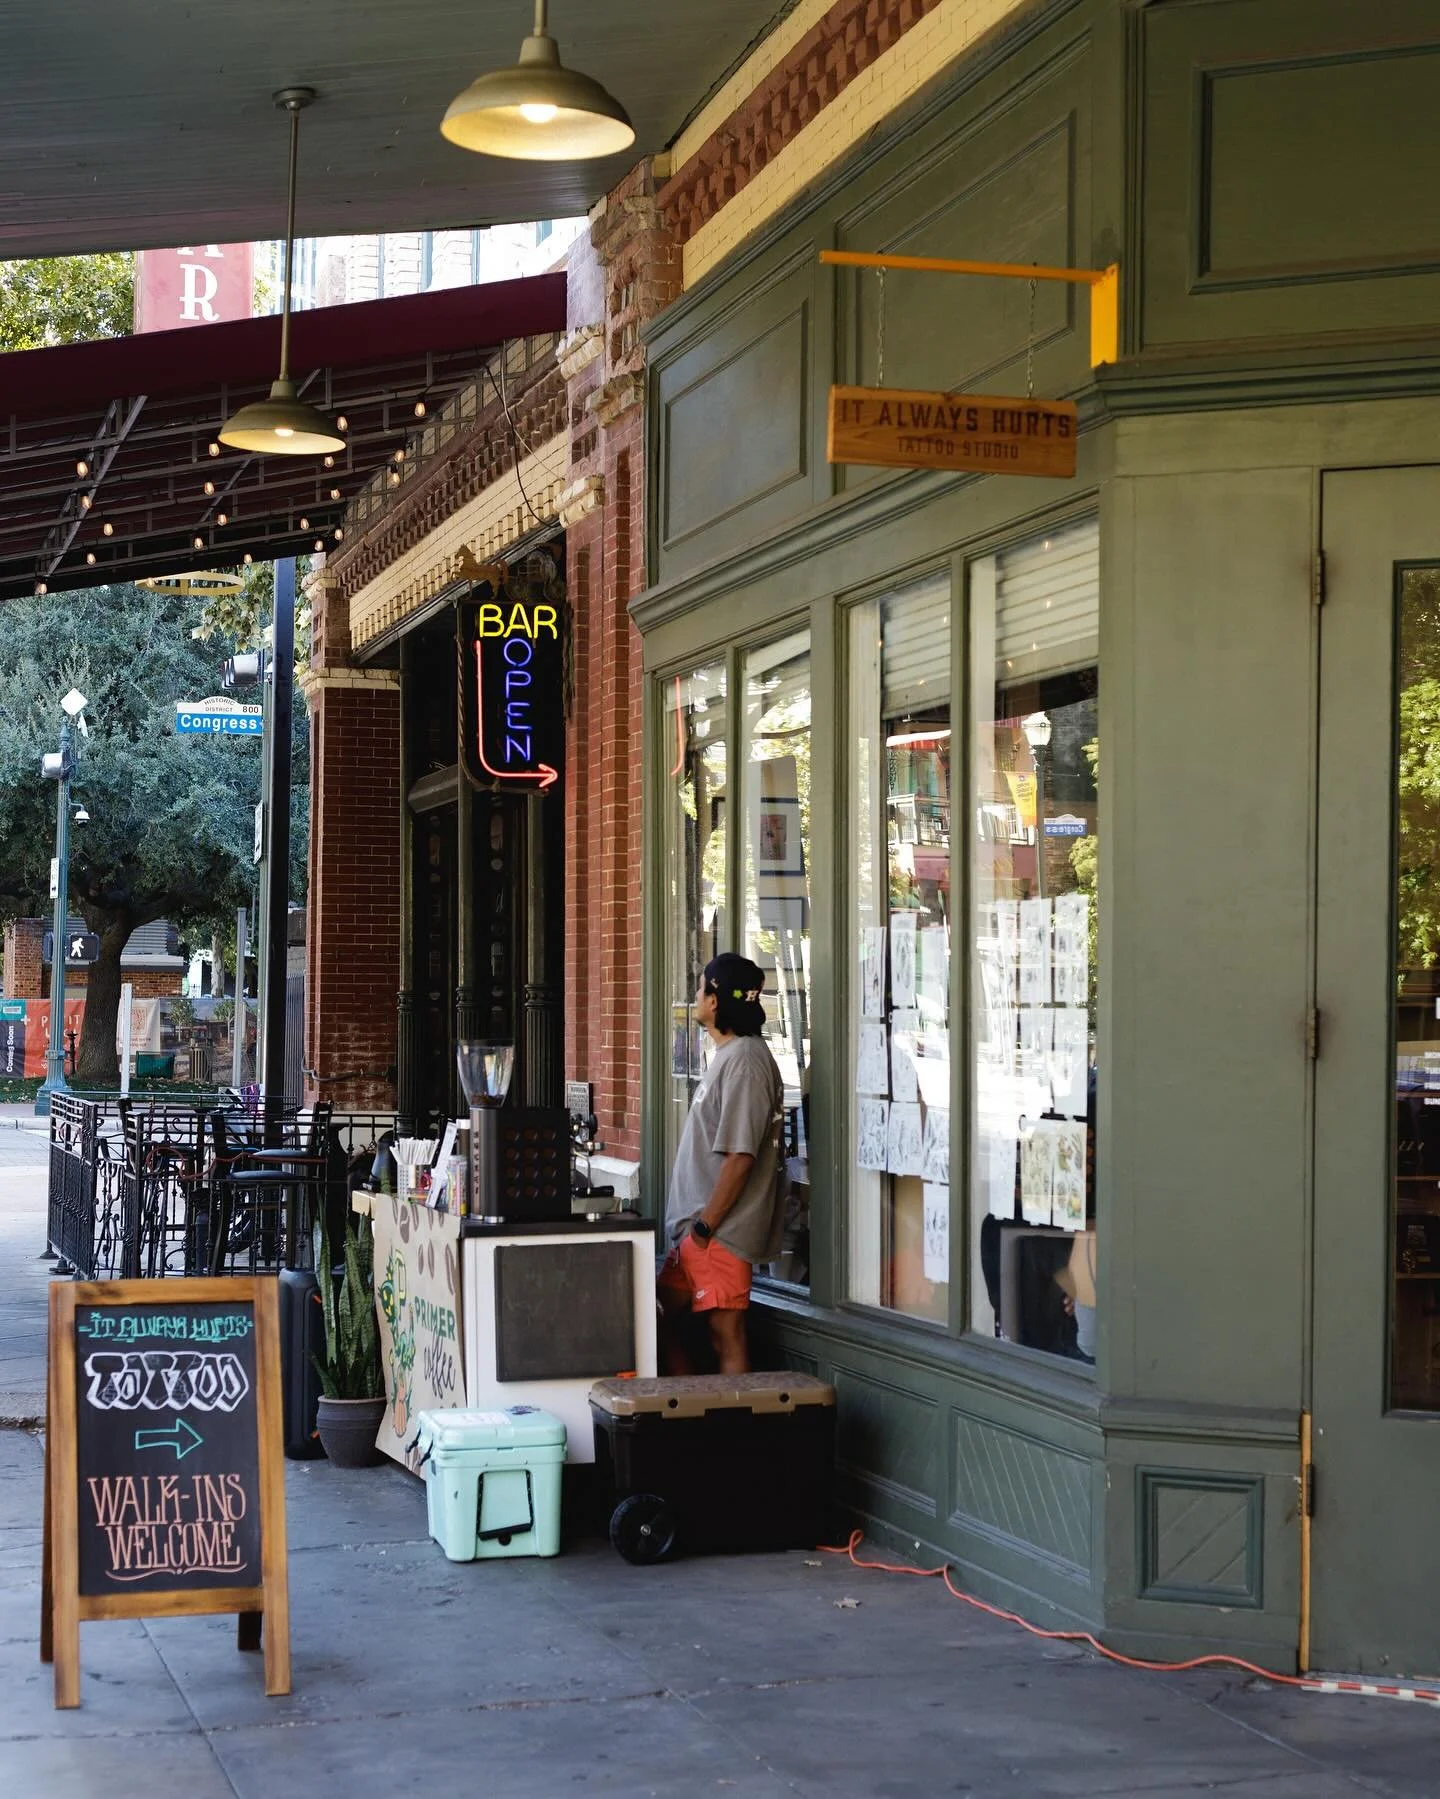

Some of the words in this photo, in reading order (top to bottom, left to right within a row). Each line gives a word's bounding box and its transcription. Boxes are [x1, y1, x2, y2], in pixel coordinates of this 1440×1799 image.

[841, 398, 865, 424] IT
[877, 401, 979, 433] ALWAYS
[992, 409, 1073, 438] HURTS
[896, 436, 954, 456] TATTOO
[963, 442, 1020, 460] STUDIO
[479, 602, 558, 640] BAR
[242, 705, 259, 714] 800
[503, 638, 533, 764] OPEN
[180, 714, 258, 732] Congress
[6, 1025, 15, 1046] Soon
[6, 1045, 15, 1073] Coming
[414, 1296, 456, 1341] PRIMER
[87, 1474, 246, 1526] WALK-INS
[104, 1520, 241, 1570] WELCOME
